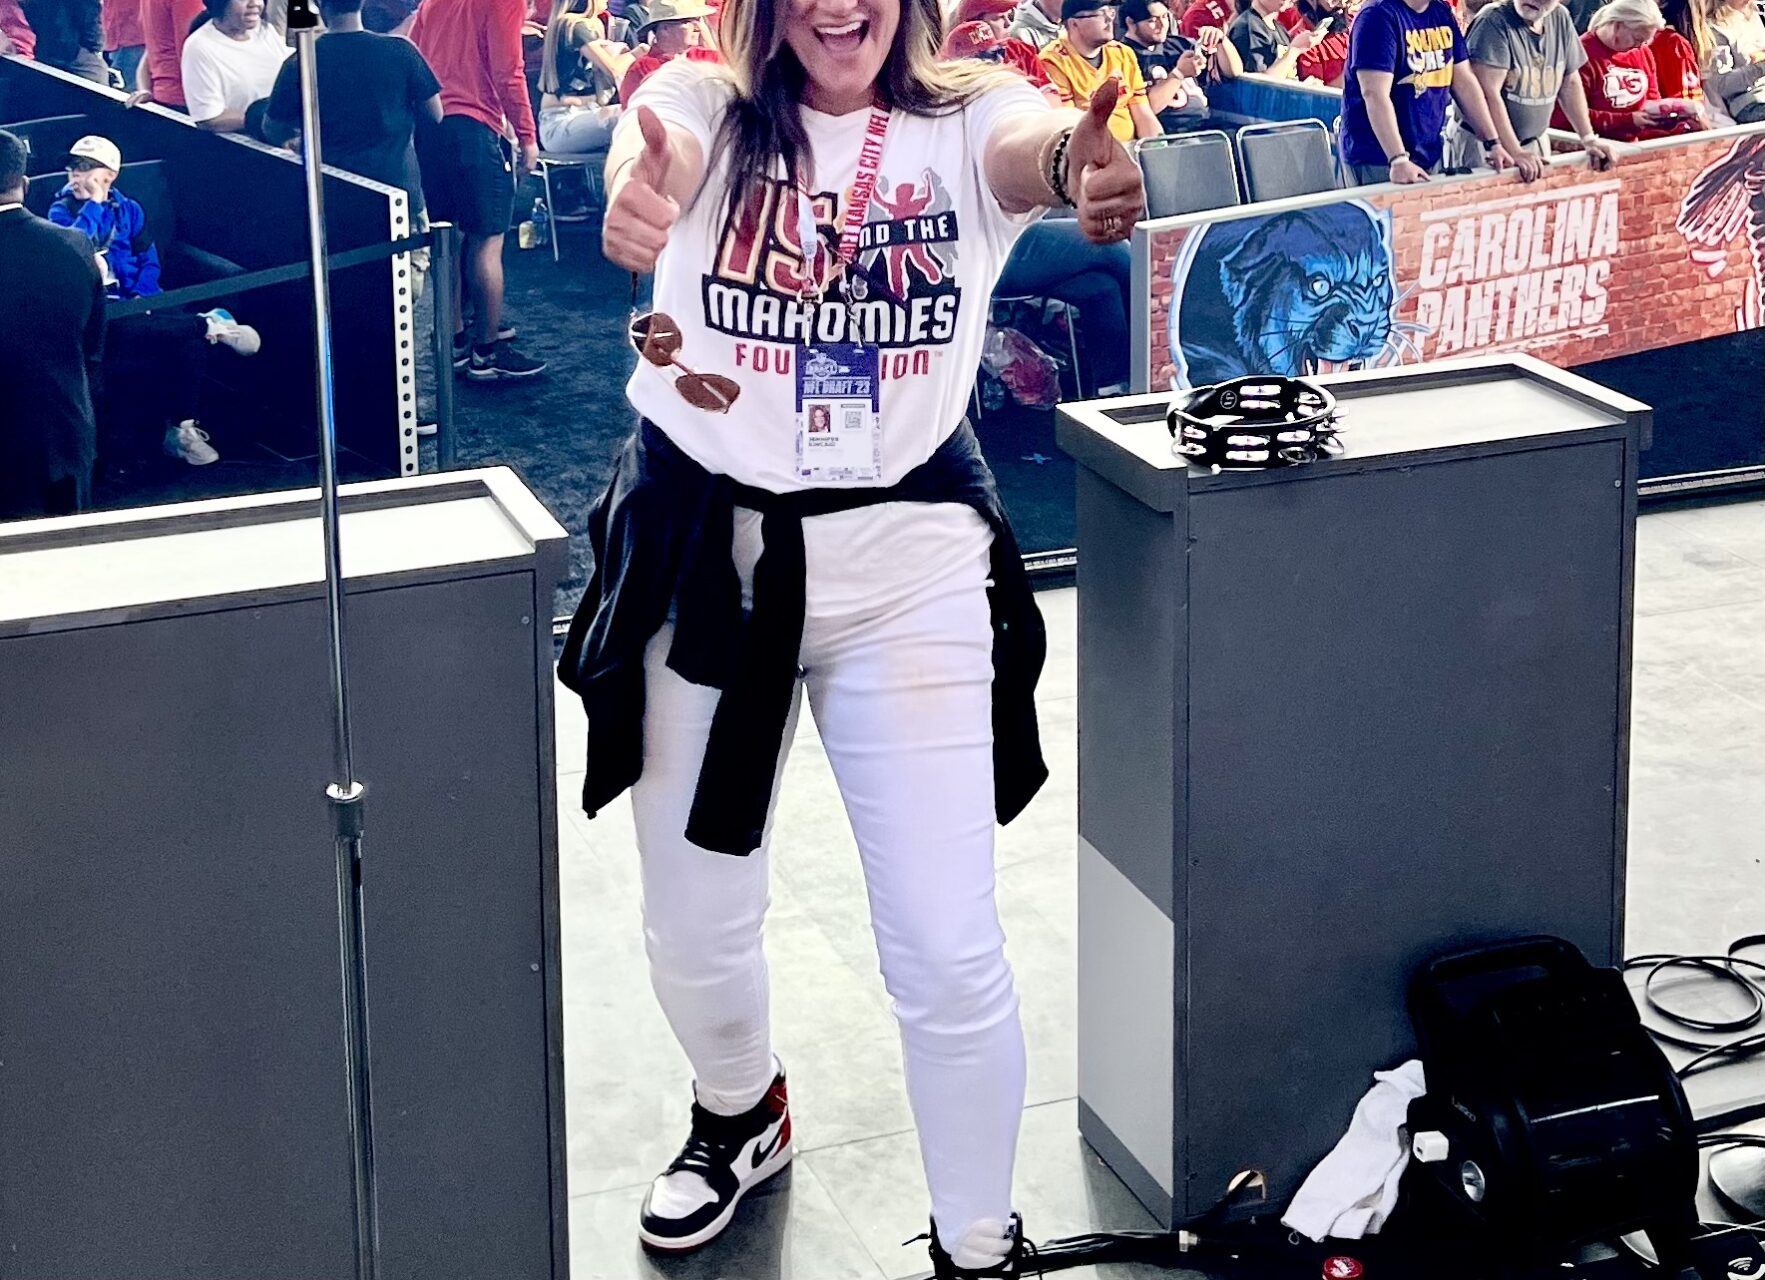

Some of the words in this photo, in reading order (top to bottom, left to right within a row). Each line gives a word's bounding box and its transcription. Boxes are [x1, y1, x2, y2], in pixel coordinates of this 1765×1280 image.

[1405, 25, 1453, 55] SOUND
[868, 114, 890, 137] NFL
[858, 137, 884, 169] CITY
[845, 171, 876, 228] KANSAS
[858, 223, 890, 249] ND
[904, 215, 949, 241] THE
[1419, 192, 1620, 290] CAROLINA
[707, 283, 957, 344] MAHOMIES
[1412, 260, 1611, 363] PANTHERS
